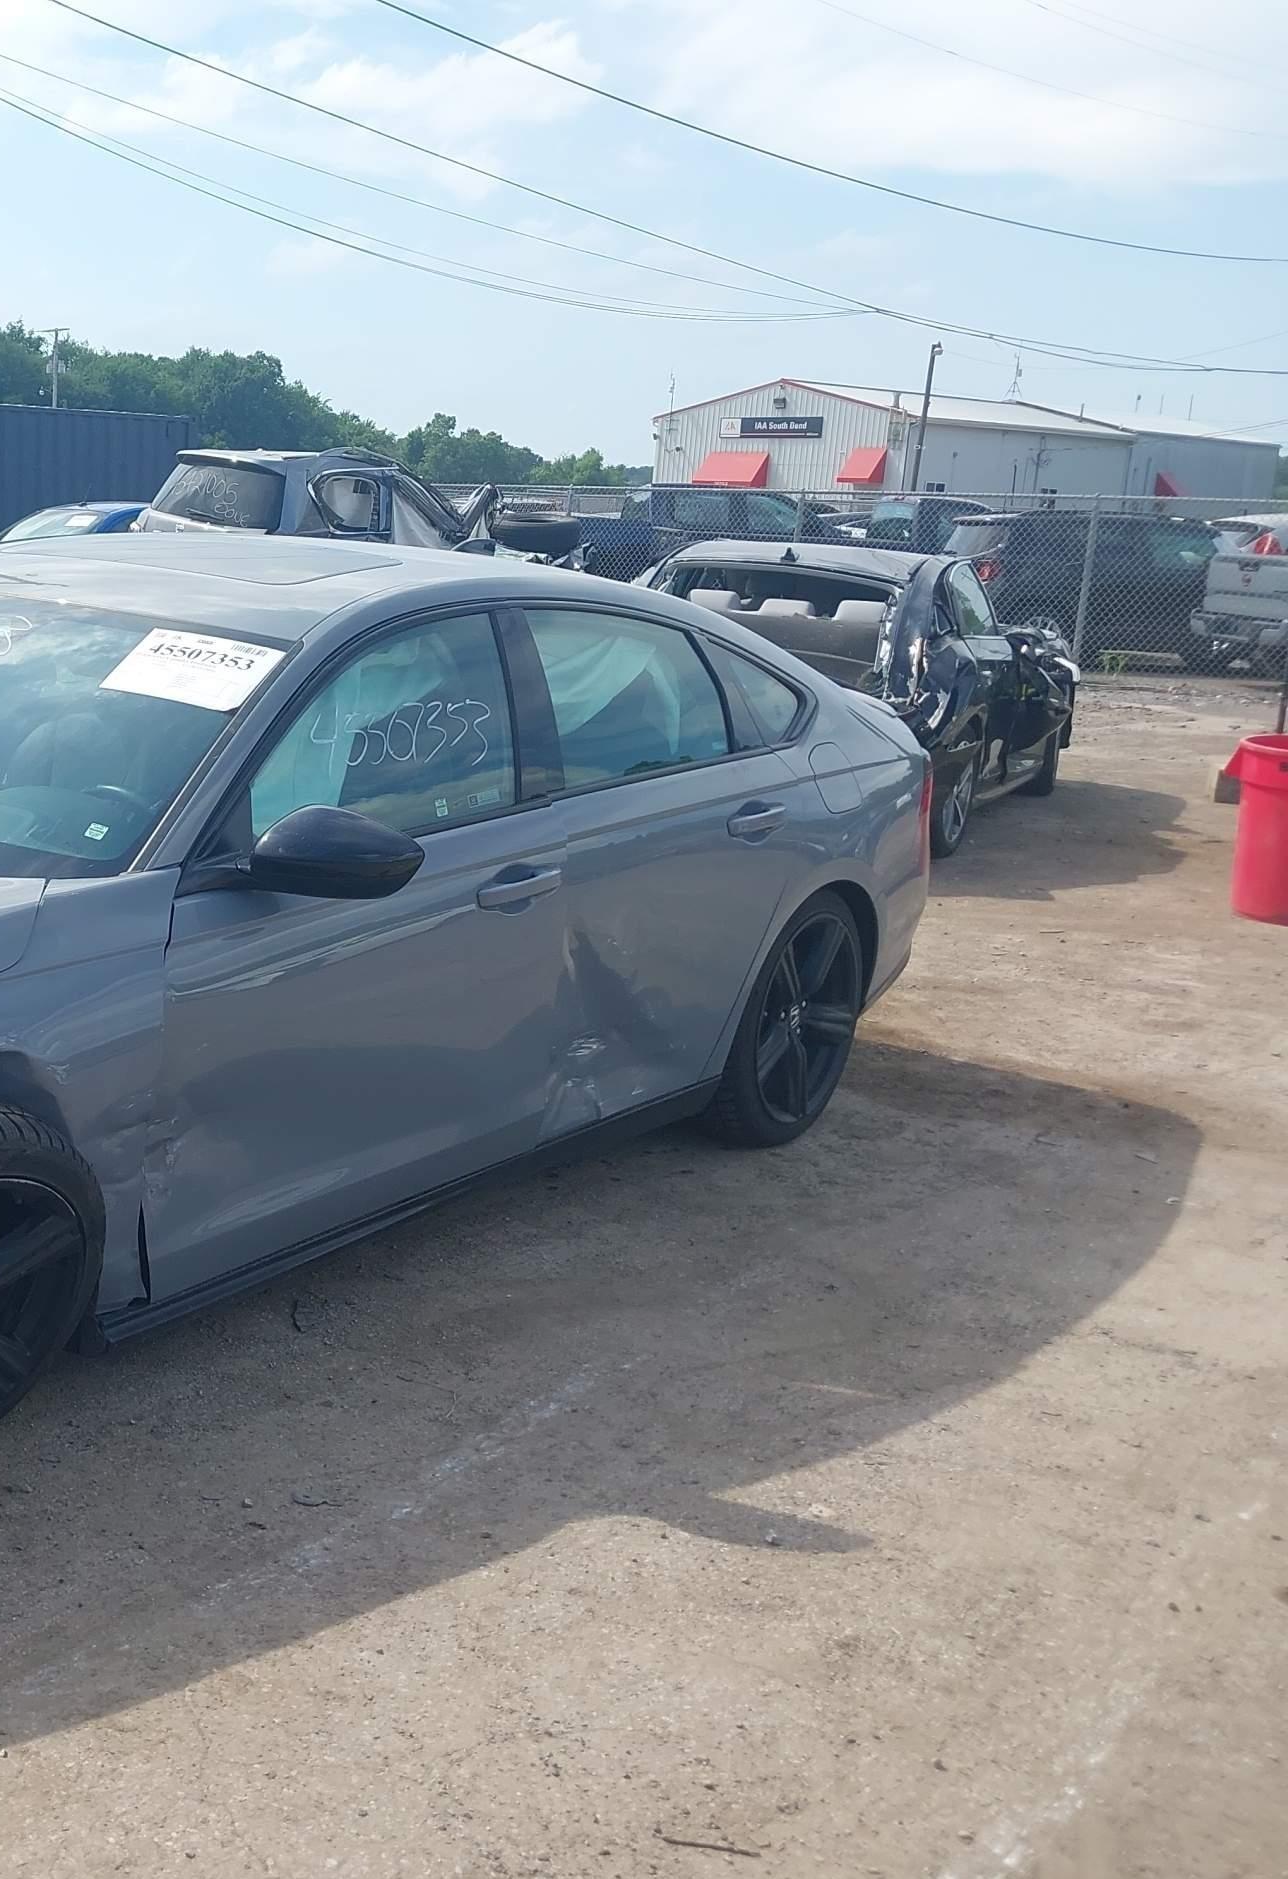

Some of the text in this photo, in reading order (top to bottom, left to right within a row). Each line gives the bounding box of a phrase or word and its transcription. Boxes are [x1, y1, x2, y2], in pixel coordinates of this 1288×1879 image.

[754, 421, 767, 430] IAA
[768, 421, 788, 430] South
[149, 643, 255, 671] 45507353
[309, 699, 491, 784] 45507353
